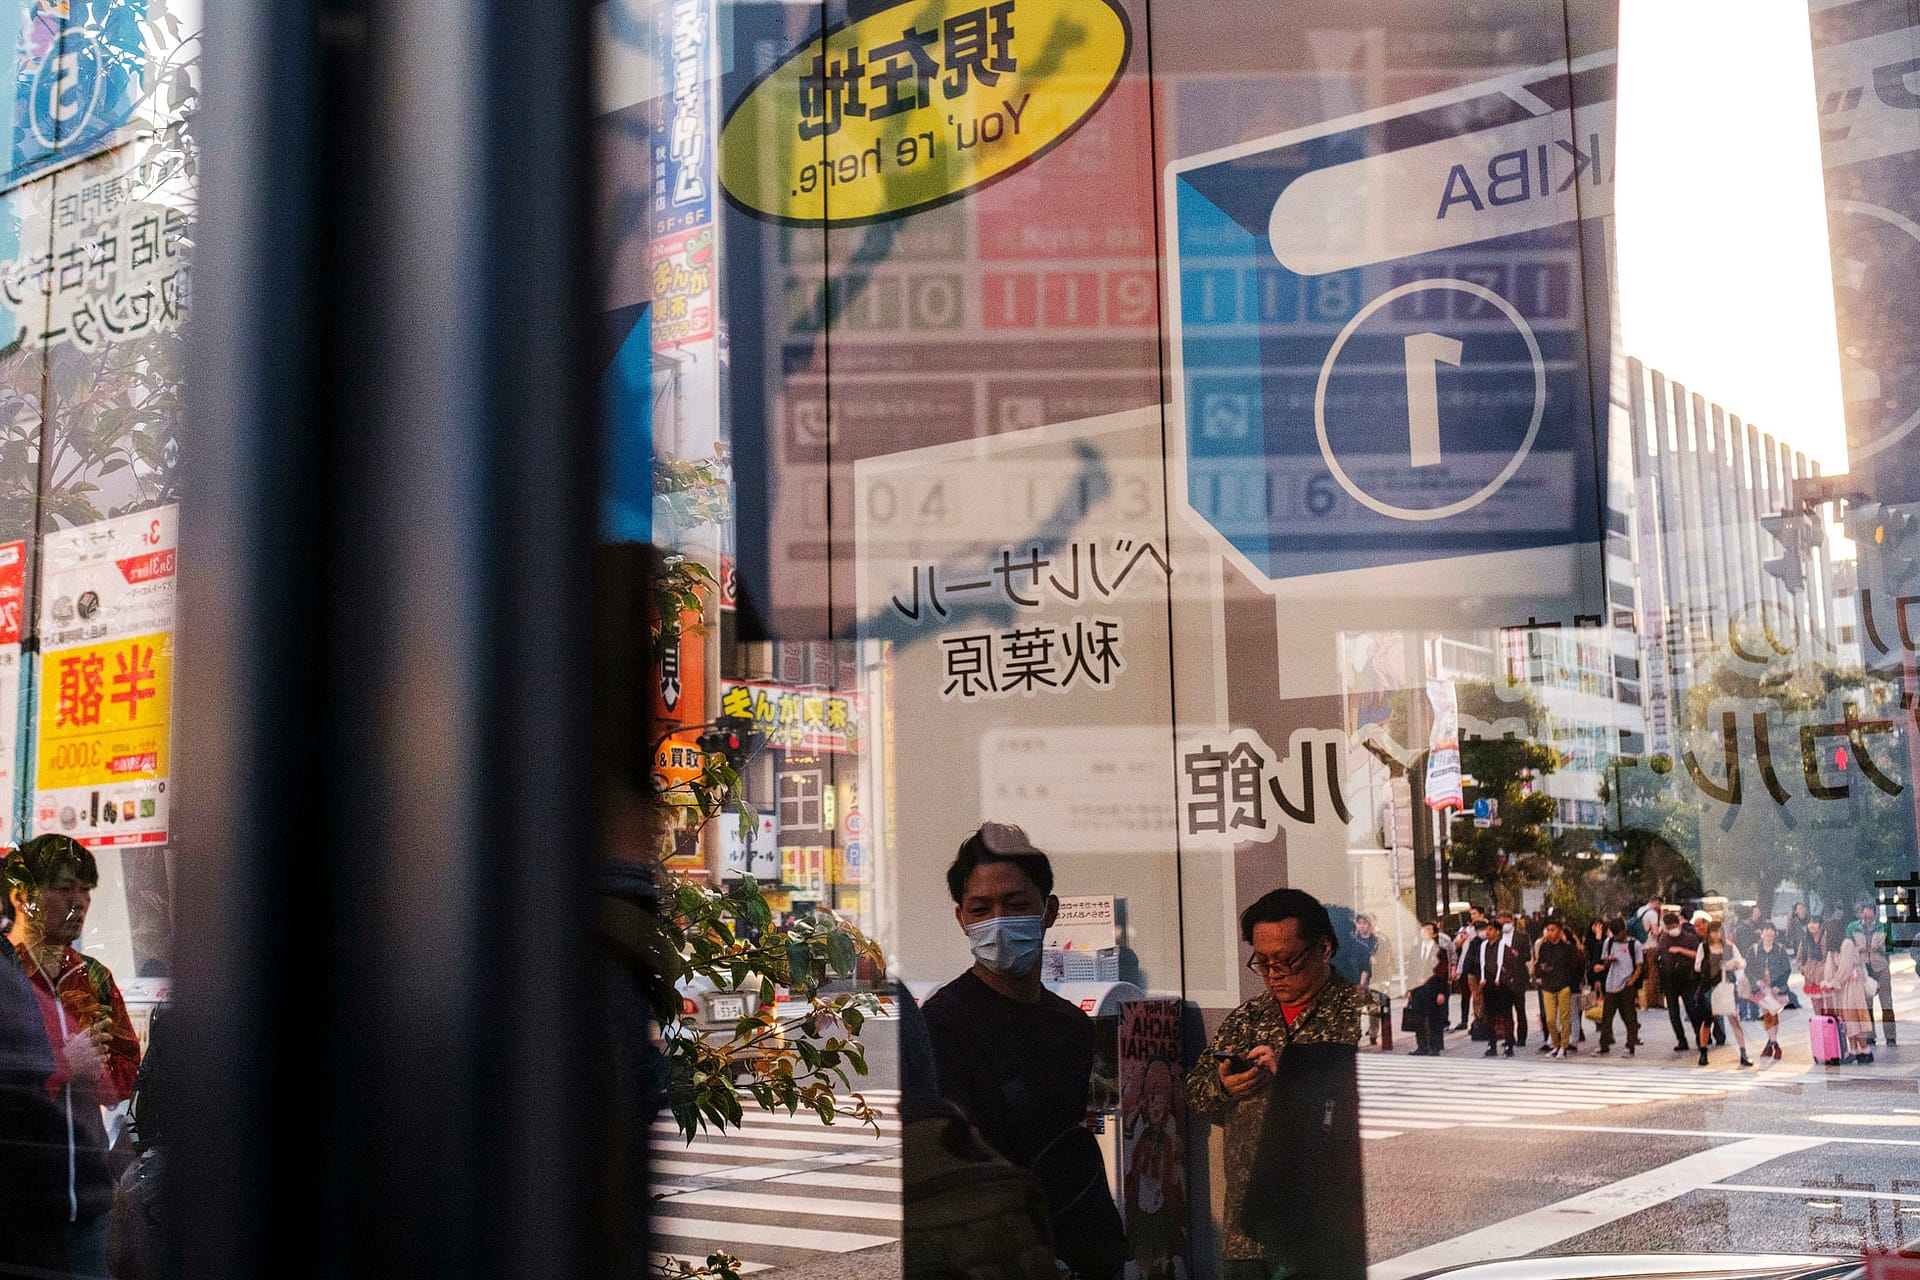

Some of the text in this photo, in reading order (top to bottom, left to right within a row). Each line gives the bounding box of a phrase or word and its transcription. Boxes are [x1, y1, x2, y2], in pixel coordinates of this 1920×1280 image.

[653, 261, 709, 295] まんが
[671, 747, 699, 768] 買取
